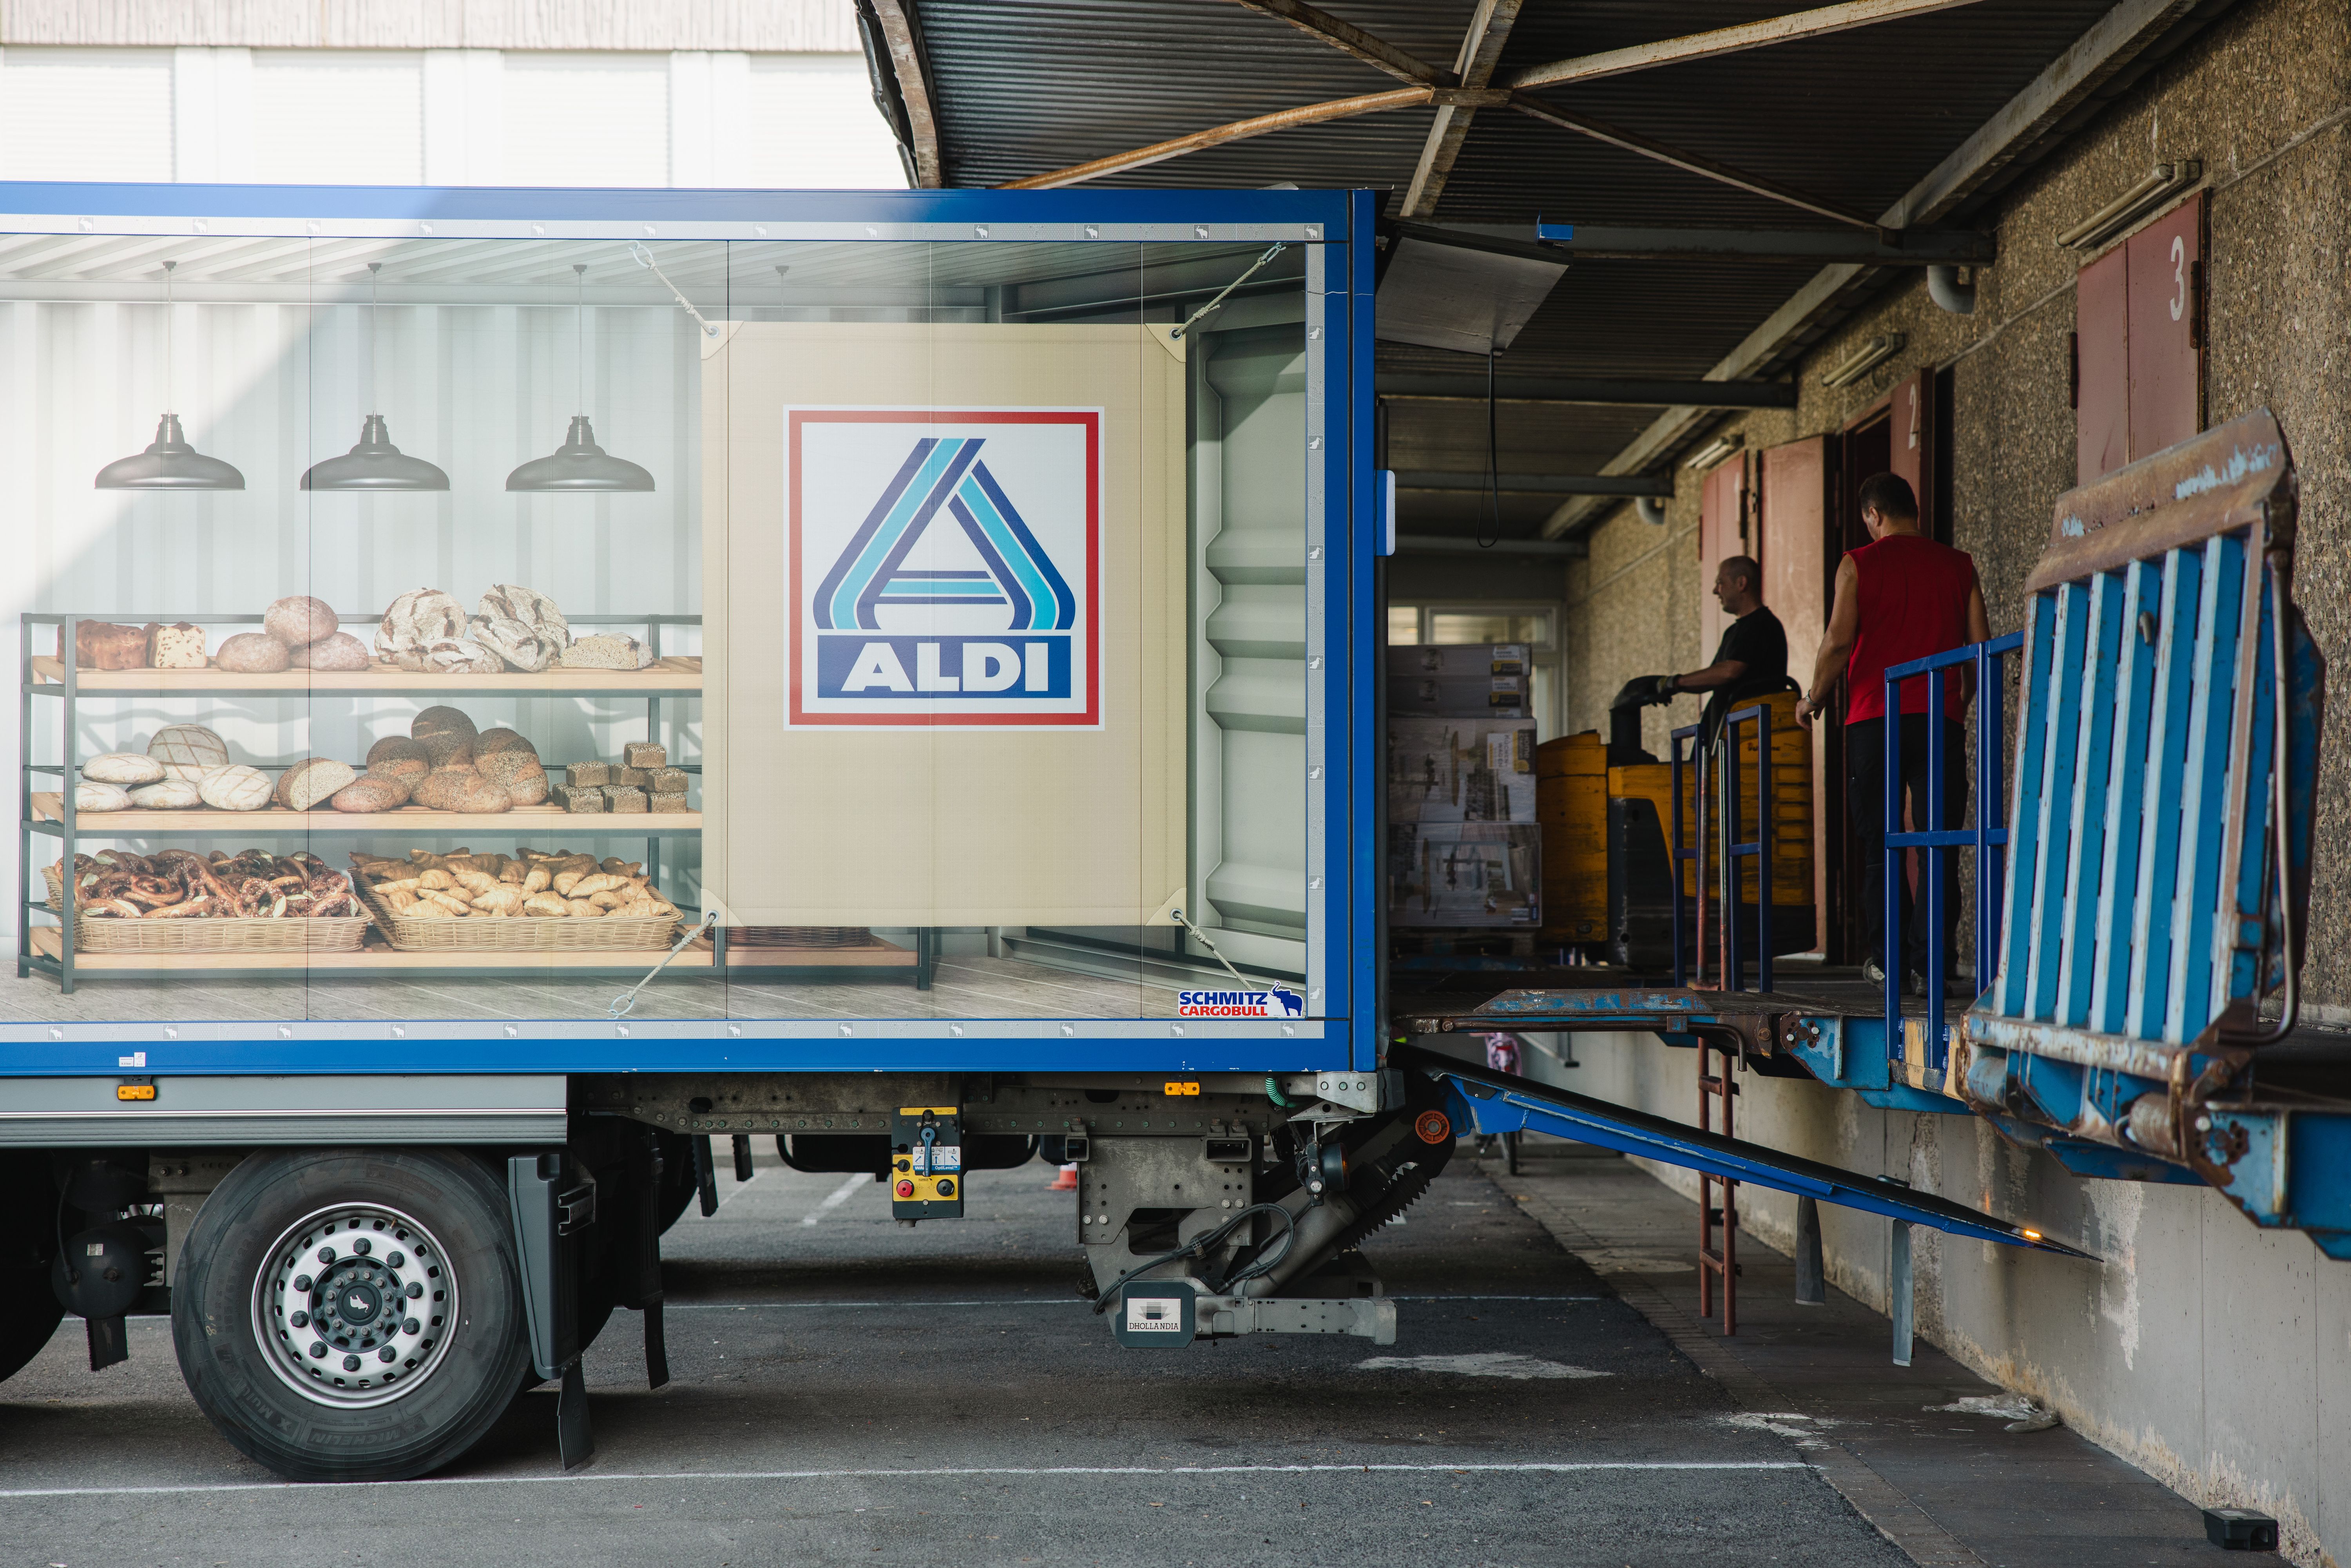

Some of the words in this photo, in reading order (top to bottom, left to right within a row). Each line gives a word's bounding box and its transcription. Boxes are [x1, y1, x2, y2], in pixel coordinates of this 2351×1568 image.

[2169, 235, 2184, 322] 3
[1908, 383, 1918, 450] 2
[841, 643, 1048, 692] ALDI
[1179, 992, 1268, 1005] SCHMITZ
[1179, 1006, 1268, 1016] CARGOBULL
[310, 1428, 402, 1446] MICHELIN
